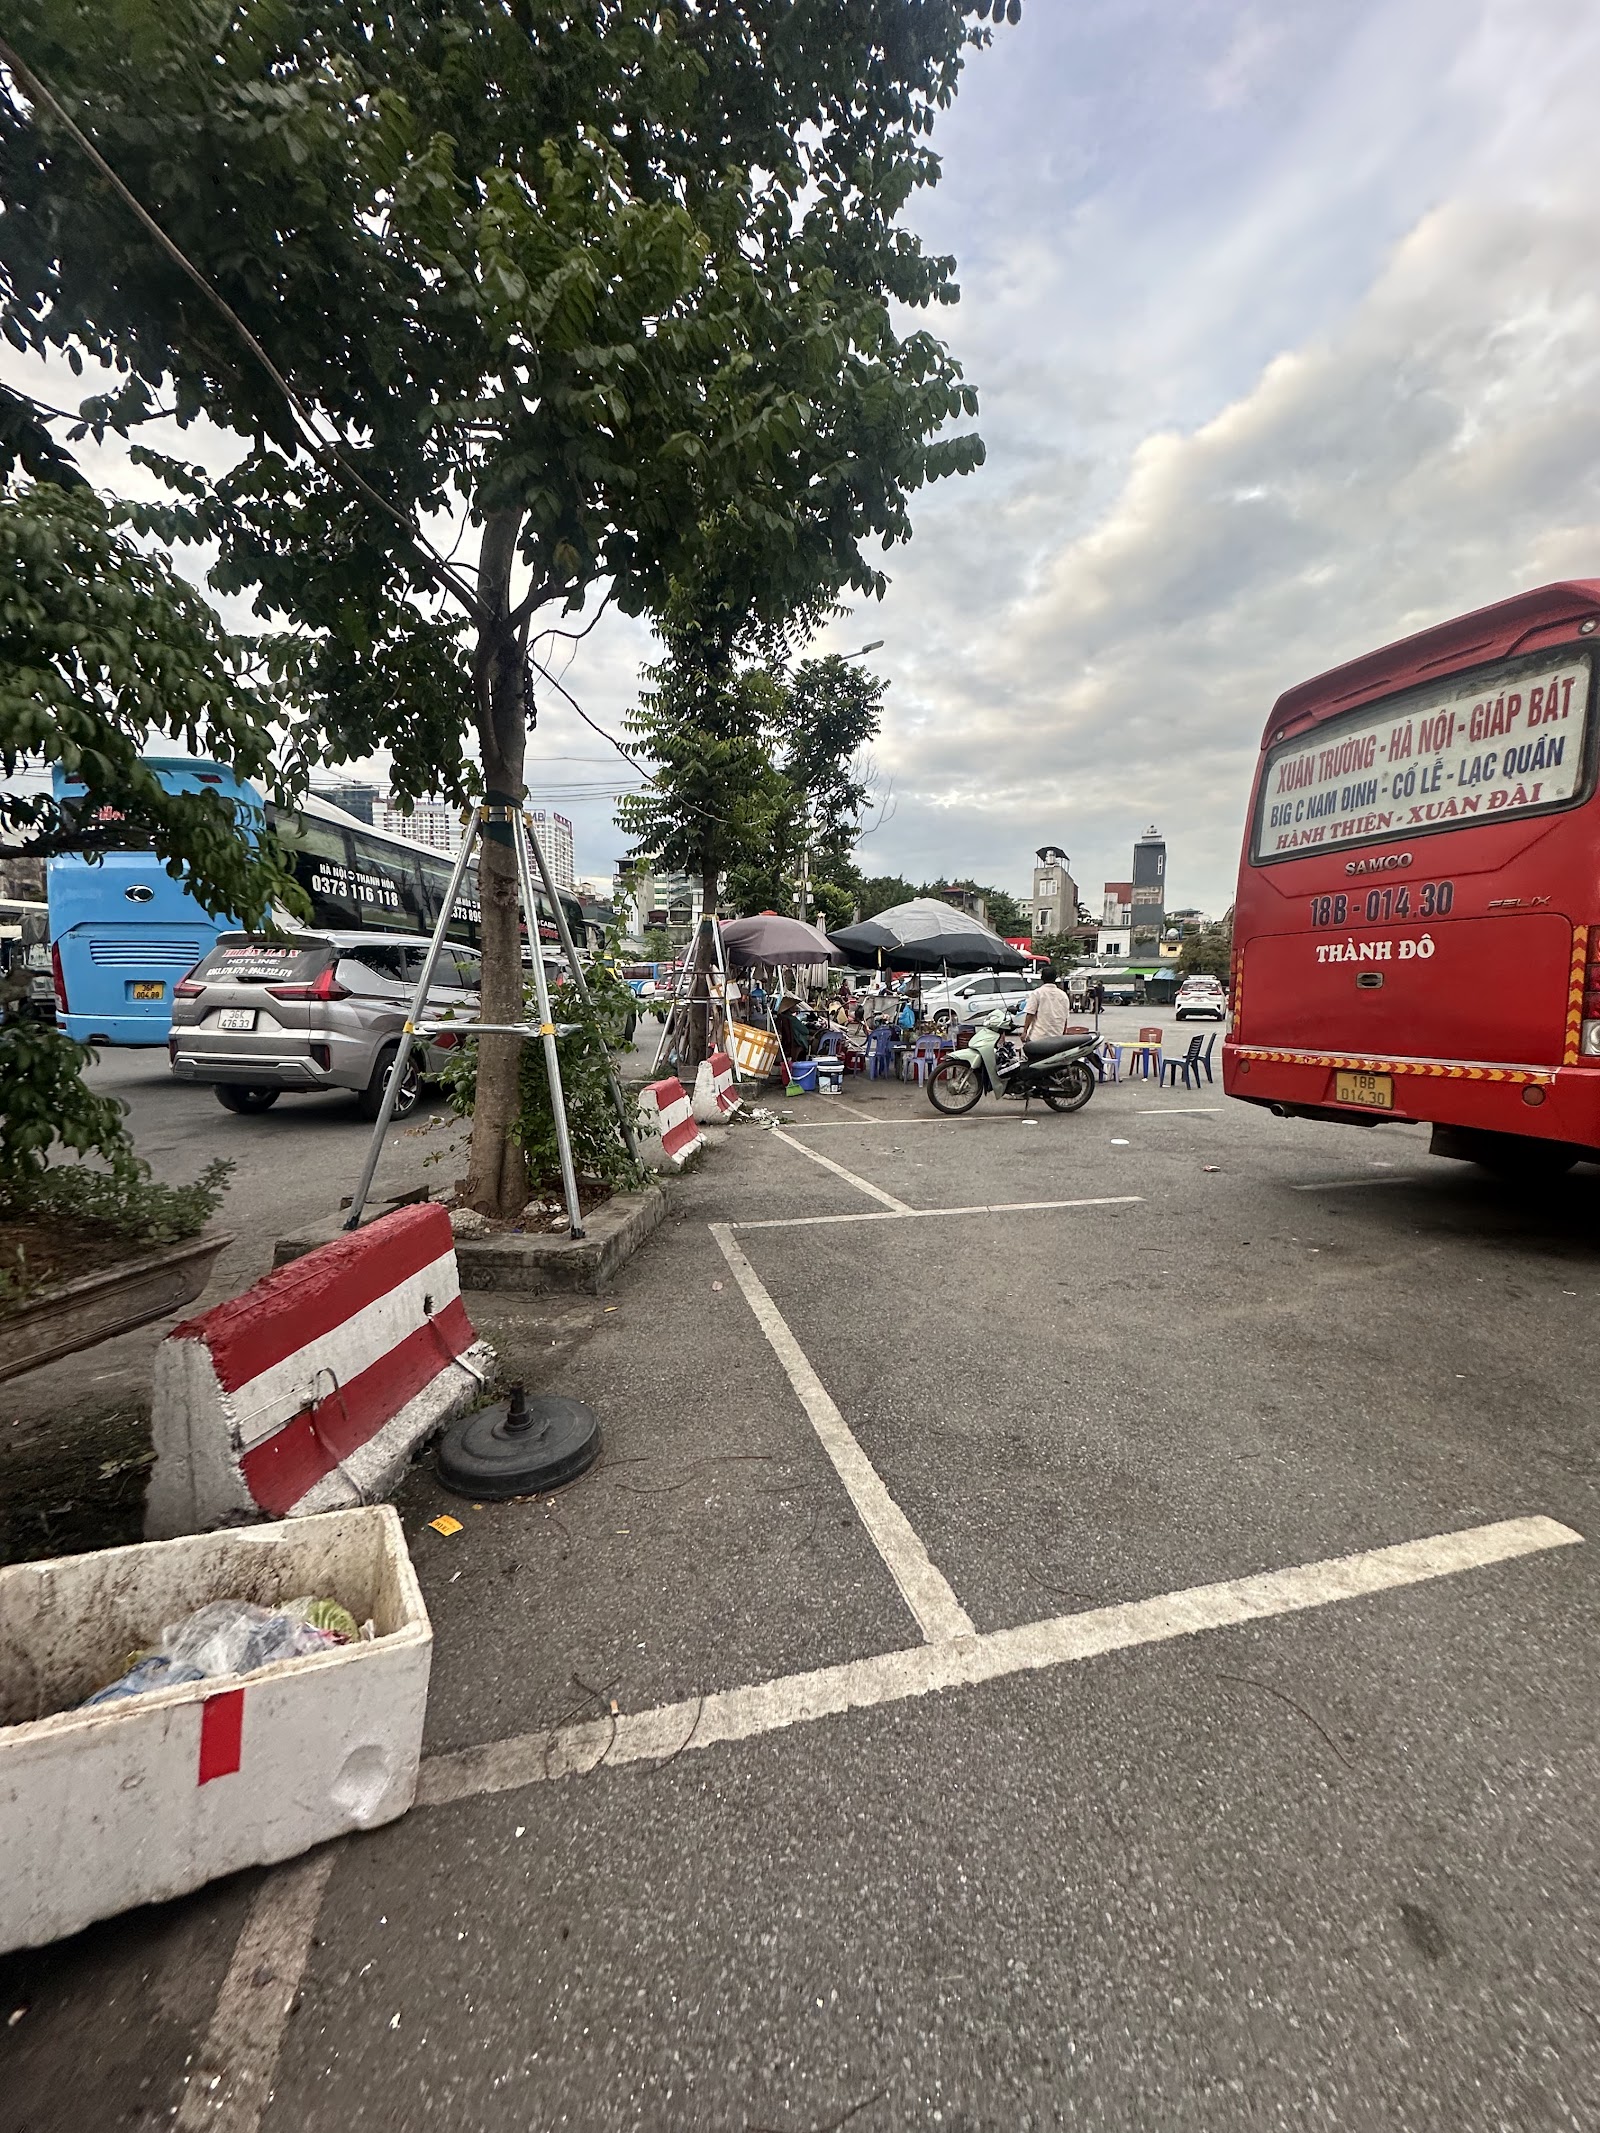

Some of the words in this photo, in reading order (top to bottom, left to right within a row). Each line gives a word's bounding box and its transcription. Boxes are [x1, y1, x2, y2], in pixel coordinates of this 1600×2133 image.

[1277, 755, 1315, 794] XUÂN
[1318, 737, 1377, 782] TRƯỜNG
[1388, 719, 1413, 762] HÀ
[1418, 709, 1456, 756] NỘI
[1469, 691, 1522, 743] GIÁP
[1527, 675, 1575, 728] BÁT
[1270, 802, 1293, 828] BIG
[1295, 799, 1304, 823] C
[1306, 790, 1338, 820] NAM
[1341, 779, 1378, 812] ĐỊNH
[1392, 762, 1419, 800] CỔ
[1420, 757, 1443, 794] LỄ
[1458, 752, 1498, 788] LẠC
[1502, 733, 1566, 779] QUẦN
[1276, 829, 1326, 850] HÀNH
[1330, 811, 1394, 839] THIỆN
[1406, 794, 1483, 824] XUÂN
[1487, 782, 1544, 810] ĐÀI
[320, 863, 332, 876] HÀ
[333, 866, 348, 880] NỘI
[356, 872, 380, 887] THANH
[1344, 852, 1413, 877] SAMCO
[311, 874, 348, 897] 0373
[350, 884, 375, 902] 116
[377, 889, 399, 907] 118
[1488, 895, 1552, 910] FELIX
[451, 905, 468, 921] 373
[1310, 893, 1348, 927] 18B
[1365, 880, 1455, 922] 014.30
[1316, 938, 1393, 963] THÀNH
[1398, 933, 1436, 960] ĐÔ
[221, 1019, 250, 1029] 476.33
[229, 1010, 245, 1019] 36K
[1353, 1075, 1376, 1089] 18B
[1341, 1088, 1385, 1105] 014.30
